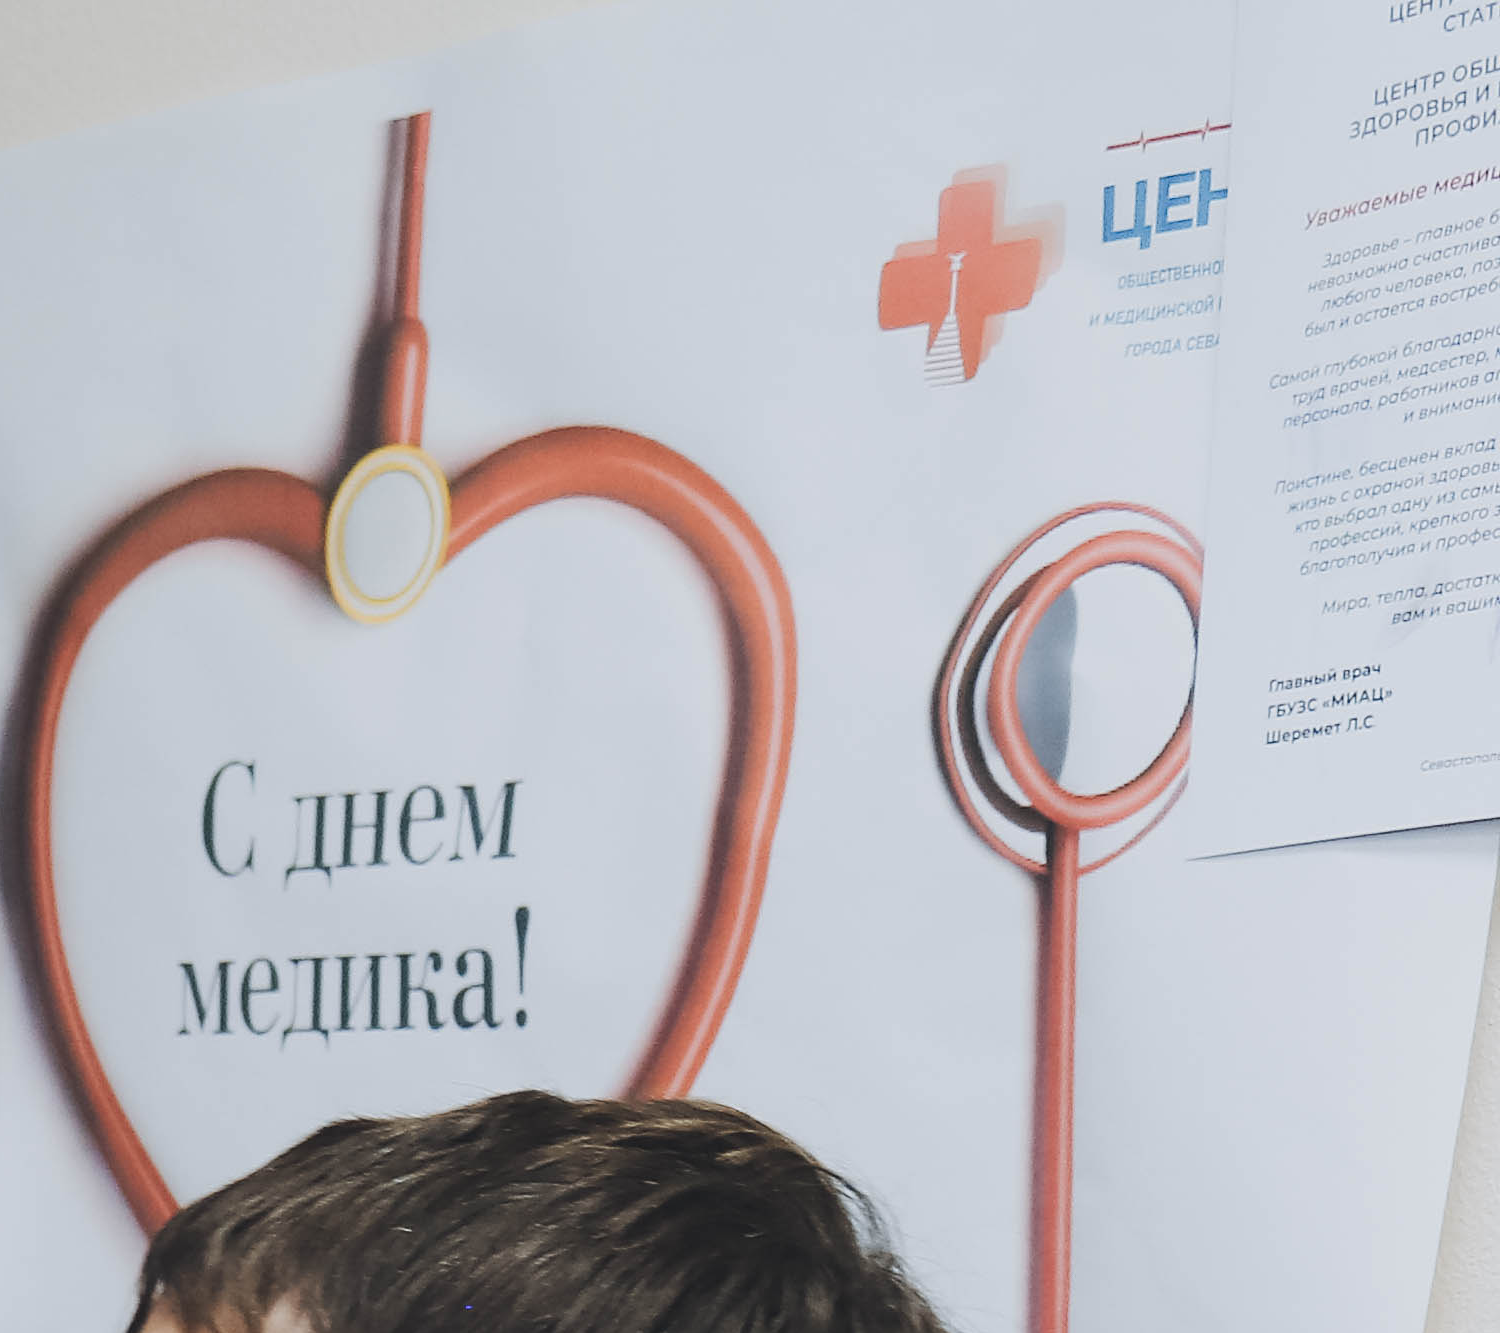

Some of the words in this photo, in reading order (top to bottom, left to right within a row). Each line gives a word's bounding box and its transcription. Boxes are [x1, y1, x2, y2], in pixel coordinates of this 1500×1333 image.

[1443, 1, 1500, 32] СТАТ
[1373, 71, 1446, 106] ЦЕНТР
[1349, 90, 1467, 139] ЗДОРОВЬЯ
[1475, 83, 1490, 103] И
[1415, 108, 1500, 148] ПРОФИ
[1305, 184, 1428, 231] Уважаемые
[1322, 237, 1399, 268] Здоровье
[1415, 216, 1485, 244] главное
[1117, 258, 1225, 290] ОБЩЕСТВЕННО
[1308, 257, 1408, 294] невозможна
[1320, 287, 1380, 313] любого
[1386, 266, 1467, 294] человека,
[1089, 312, 1101, 328] И
[1104, 294, 1214, 326] МЕДИЦИНСКОЙ
[1304, 319, 1335, 338] был
[1340, 316, 1349, 329] и
[1354, 297, 1425, 325] остается
[1429, 277, 1500, 307] востреб
[1124, 338, 1182, 359] ГОРОДА
[1269, 366, 1320, 390] Самой
[1323, 349, 1398, 377] глубокой
[1292, 387, 1326, 407] труд
[1330, 369, 1392, 397] врачей,
[1396, 350, 1490, 380] медсестер,
[1283, 398, 1373, 429] персонала,
[1378, 374, 1479, 410] работников
[1404, 410, 1414, 423] и
[1419, 391, 1500, 420] внимани
[1274, 467, 1354, 496] Поистине,
[1359, 448, 1439, 478] бесценен
[1445, 438, 1496, 460] вклад
[1286, 494, 1336, 514] жизнь
[1341, 491, 1350, 503] с
[1354, 473, 1425, 500] охраной
[1294, 517, 1320, 534] кто
[1324, 503, 1387, 529] выбрал
[1391, 494, 1433, 515] одну
[1436, 490, 1456, 505] из
[1309, 521, 1405, 554] профессий,
[1410, 506, 1489, 535] крепкого
[1300, 542, 1416, 577] благополучия
[1420, 540, 1431, 554] и
[1321, 594, 1373, 616] Мира,
[1377, 584, 1429, 605] тепла,
[1392, 608, 1426, 626] вам
[1429, 605, 1441, 618] и
[1268, 668, 1337, 693] Главный
[1342, 663, 1381, 682] врач
[1267, 698, 1317, 720] ГБУЗС
[1322, 686, 1393, 710] «МИАЦ»
[1265, 720, 1342, 745] Шеремет
[202, 759, 256, 878] С
[284, 779, 524, 891] днем
[177, 905, 531, 1053] медика!
